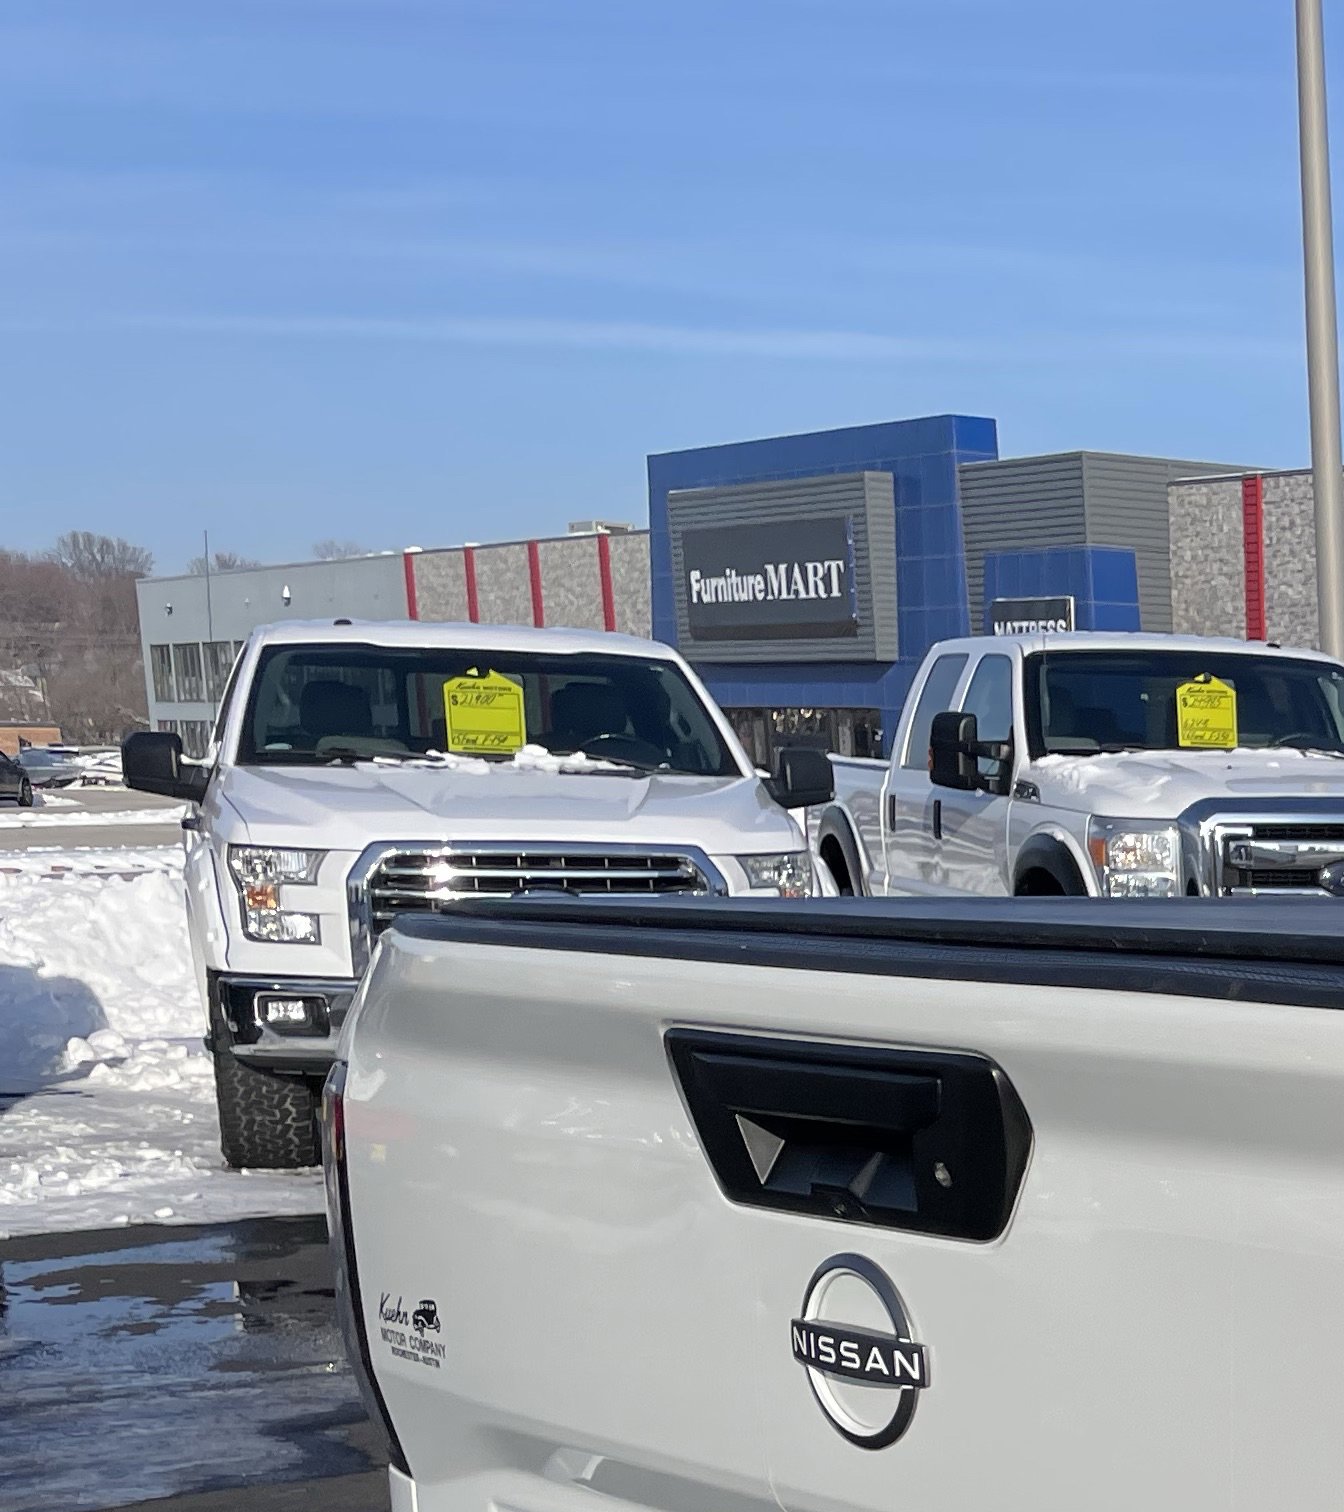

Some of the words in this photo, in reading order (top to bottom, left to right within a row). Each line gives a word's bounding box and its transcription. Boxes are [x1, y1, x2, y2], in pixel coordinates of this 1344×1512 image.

[994, 618, 1067, 636] MATTRESS
[379, 1292, 409, 1326] Kuehn
[792, 1325, 920, 1381] NISSAN
